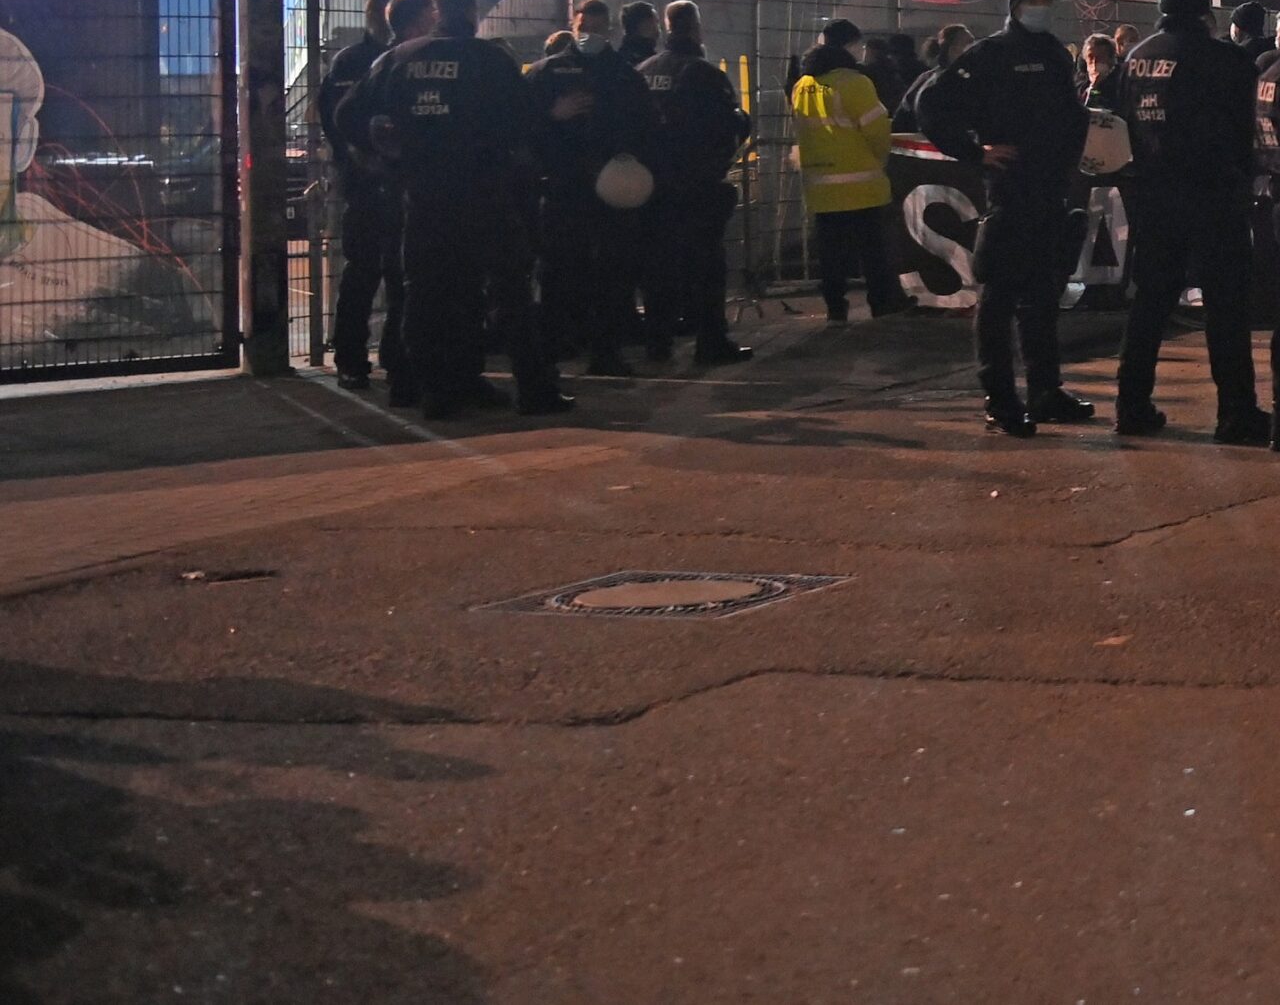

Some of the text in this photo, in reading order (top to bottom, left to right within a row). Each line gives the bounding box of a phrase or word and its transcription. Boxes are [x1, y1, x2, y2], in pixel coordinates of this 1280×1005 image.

[407, 61, 459, 79] POLIZEI
[1129, 59, 1177, 77] POLIZEI
[417, 90, 440, 103] HH
[1141, 94, 1158, 107] HH
